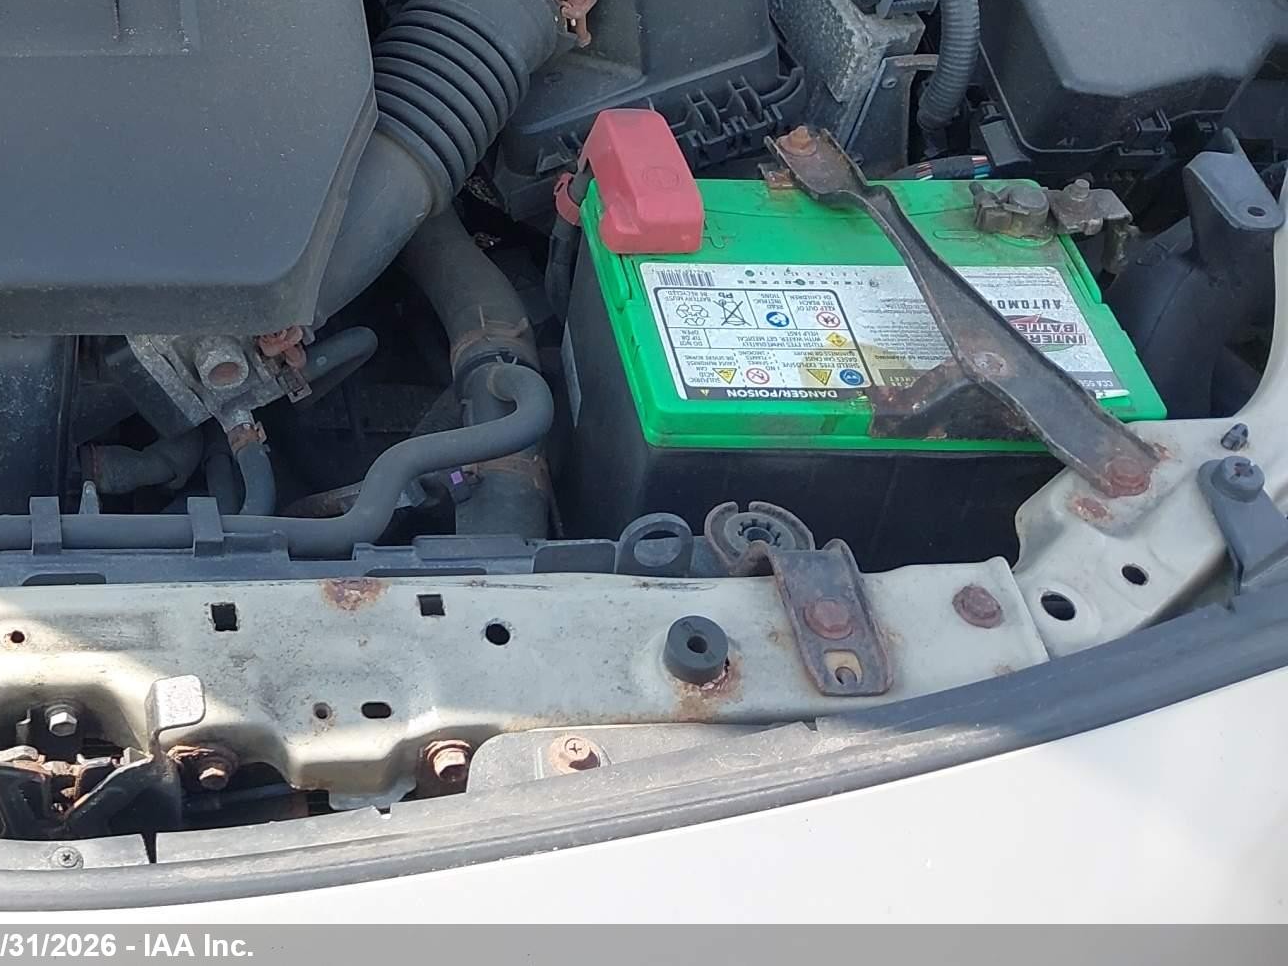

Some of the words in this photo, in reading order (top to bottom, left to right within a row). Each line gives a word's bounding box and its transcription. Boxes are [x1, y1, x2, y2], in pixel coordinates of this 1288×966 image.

[989, 299, 1061, 310] AUTOMO
[1013, 323, 1075, 333] BATTE
[726, 388, 838, 398] DANGER/POISON
